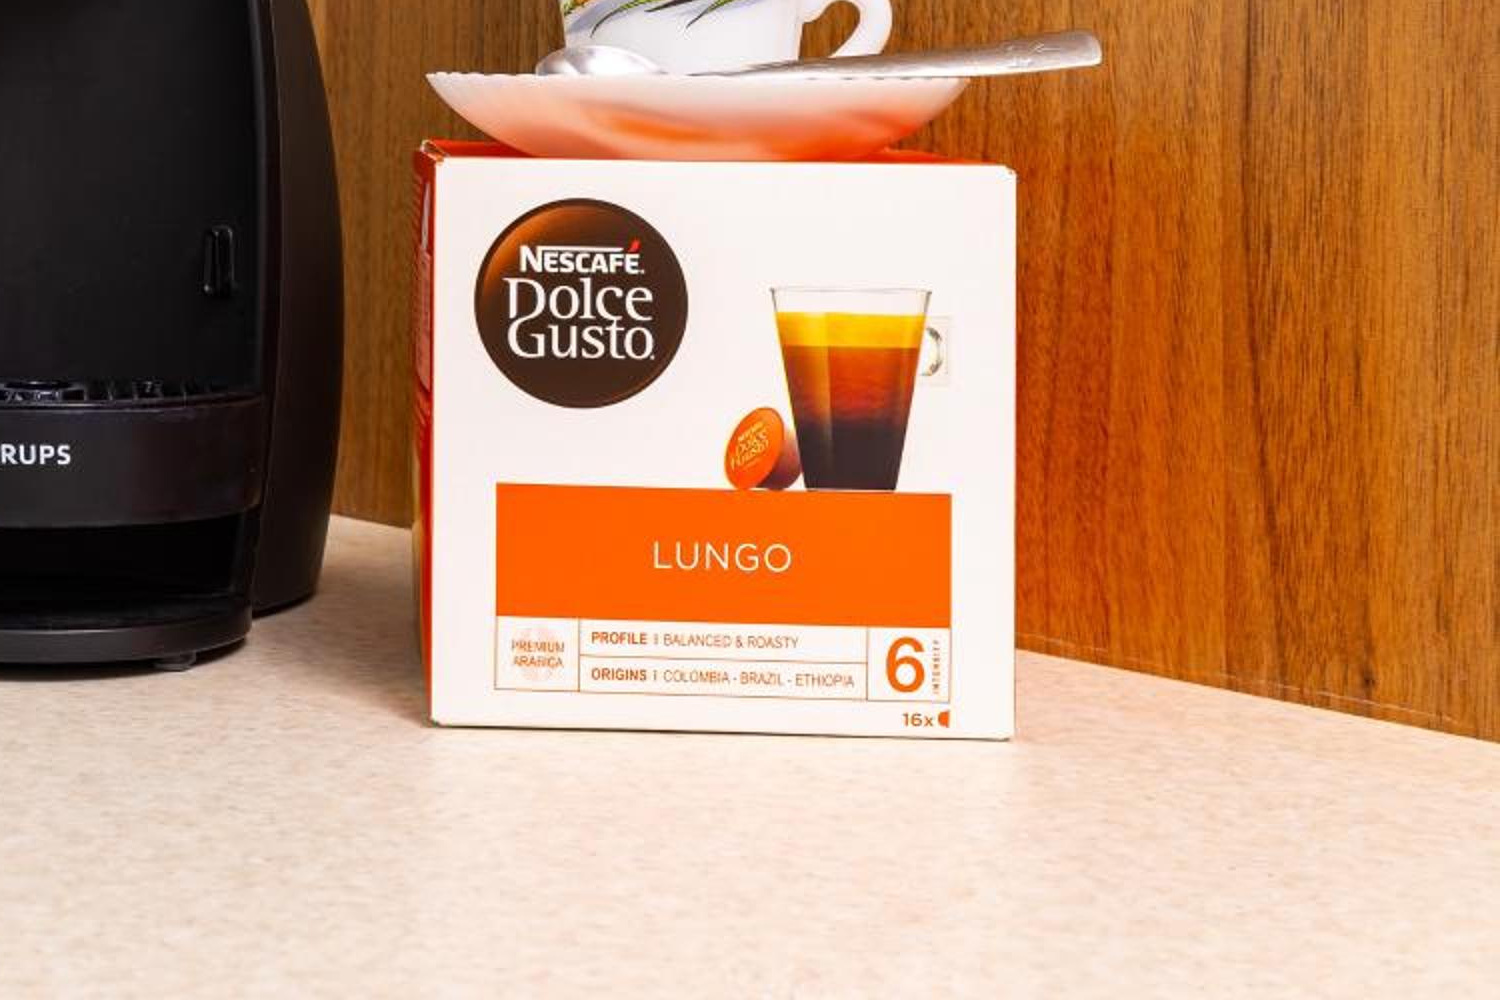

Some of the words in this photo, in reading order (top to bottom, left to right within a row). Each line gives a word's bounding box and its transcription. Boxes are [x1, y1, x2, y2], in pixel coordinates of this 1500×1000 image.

[519, 239, 641, 274] NESCAFÉ
[503, 277, 654, 321] Dolce
[507, 318, 654, 360] Gusto
[653, 541, 792, 572] LUNGO
[511, 638, 565, 653] PREMIUM
[591, 631, 648, 645] PROFILE
[663, 633, 732, 648] BALANCED
[735, 635, 744, 648] &
[747, 635, 800, 649] ROASTY
[591, 667, 647, 682] ORIGINS
[663, 669, 731, 684] COLOMBIA
[740, 671, 783, 686] BRAZIL
[795, 673, 855, 688] ETHIOPIA
[886, 636, 925, 693] 6
[902, 711, 934, 728] 16x
